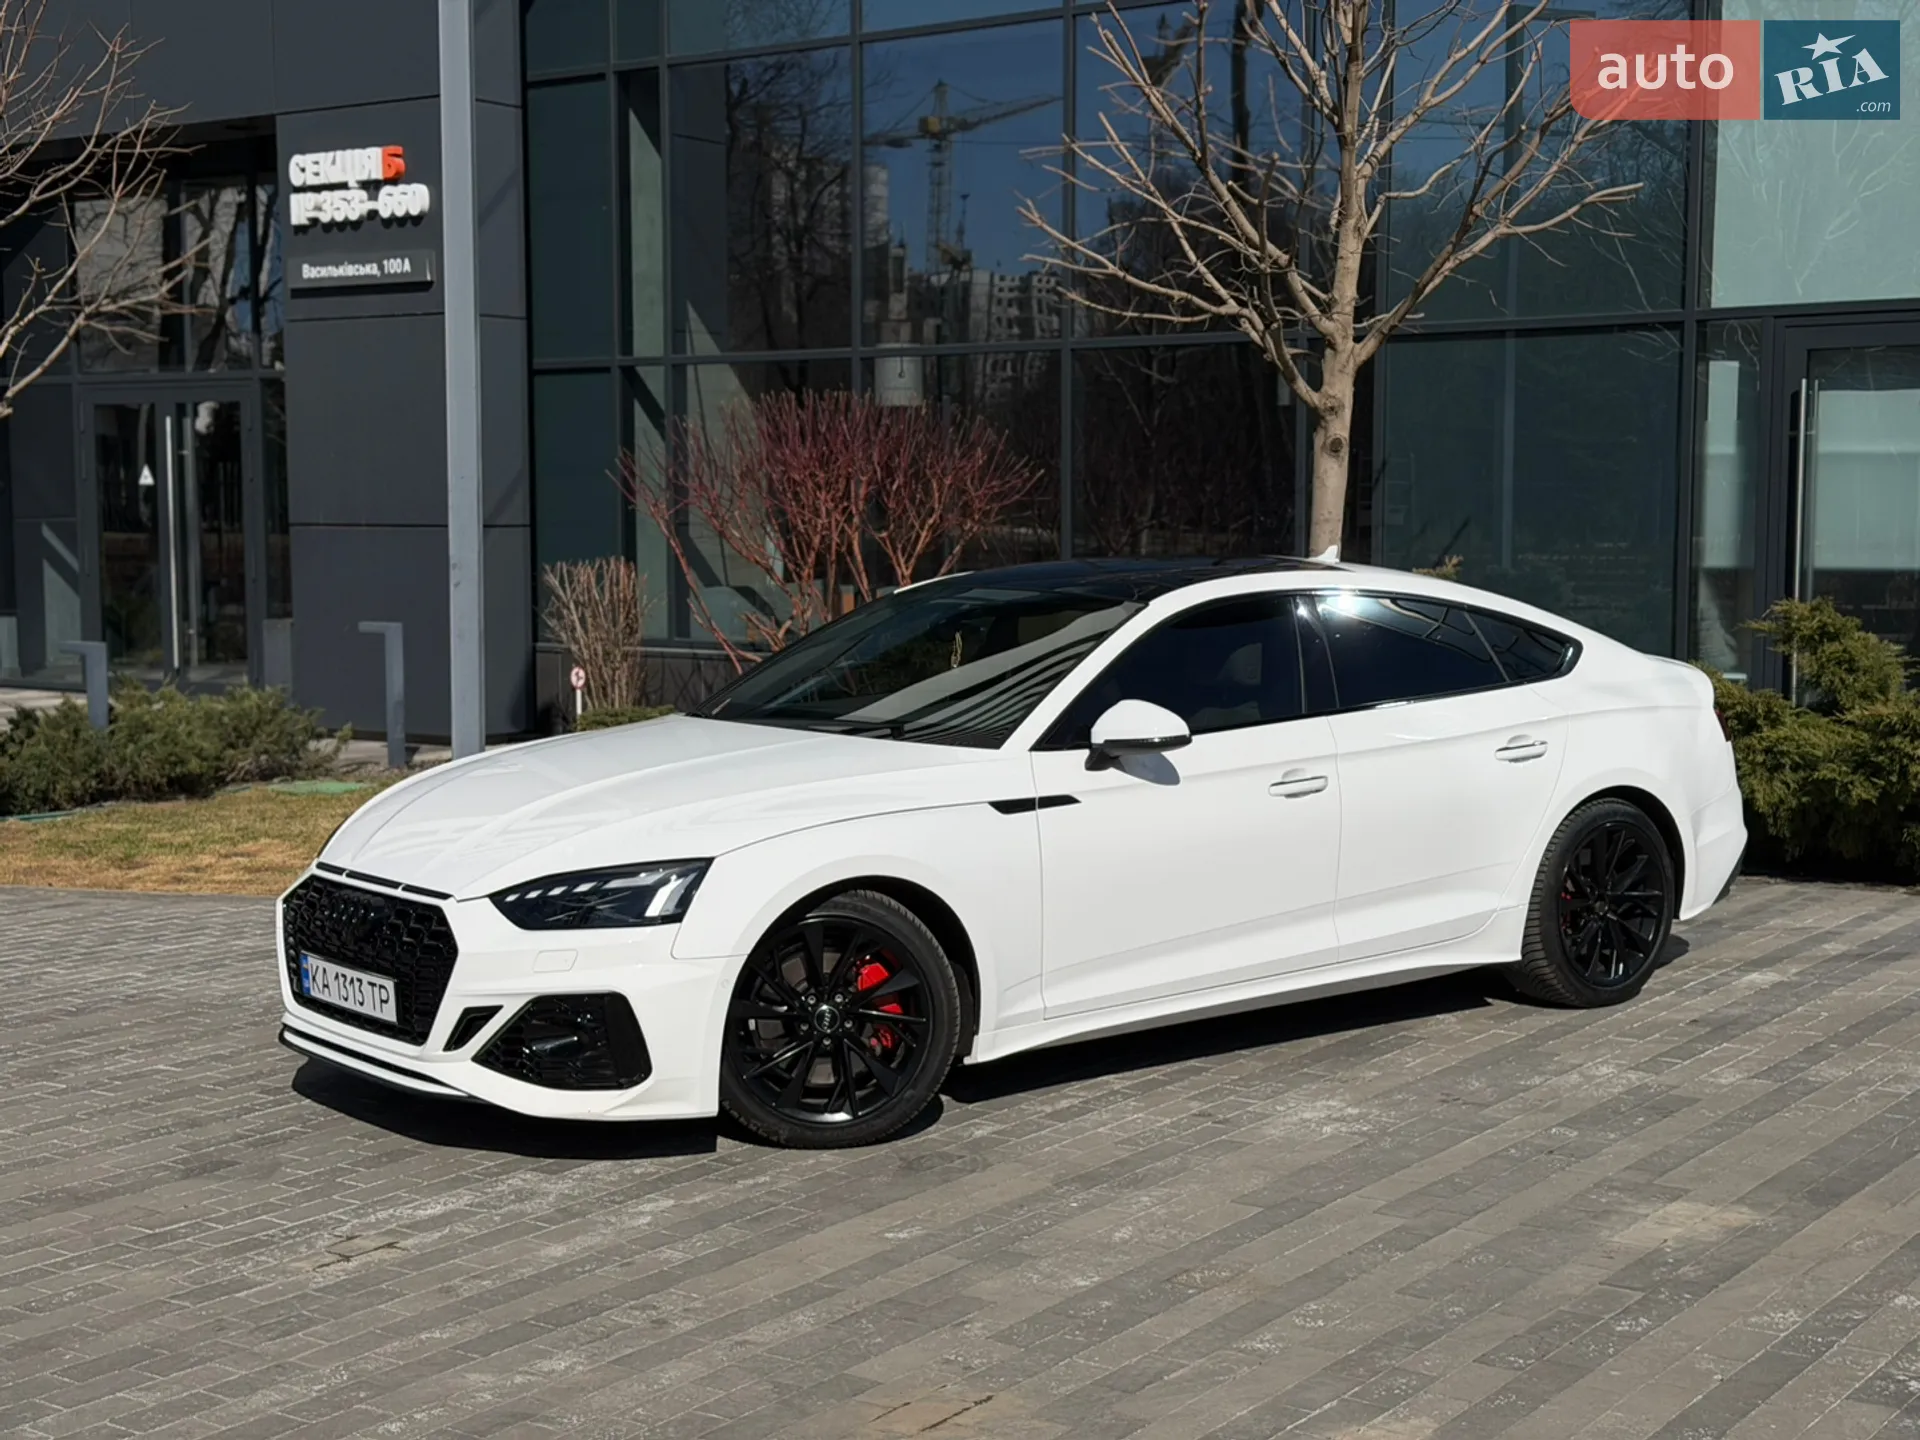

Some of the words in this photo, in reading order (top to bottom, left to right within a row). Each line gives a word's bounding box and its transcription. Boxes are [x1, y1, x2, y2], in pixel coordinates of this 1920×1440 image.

[302, 261, 381, 279] Васильківська,
[310, 963, 331, 997] KA
[334, 971, 365, 1007] 1313
[367, 981, 390, 1013] TP
